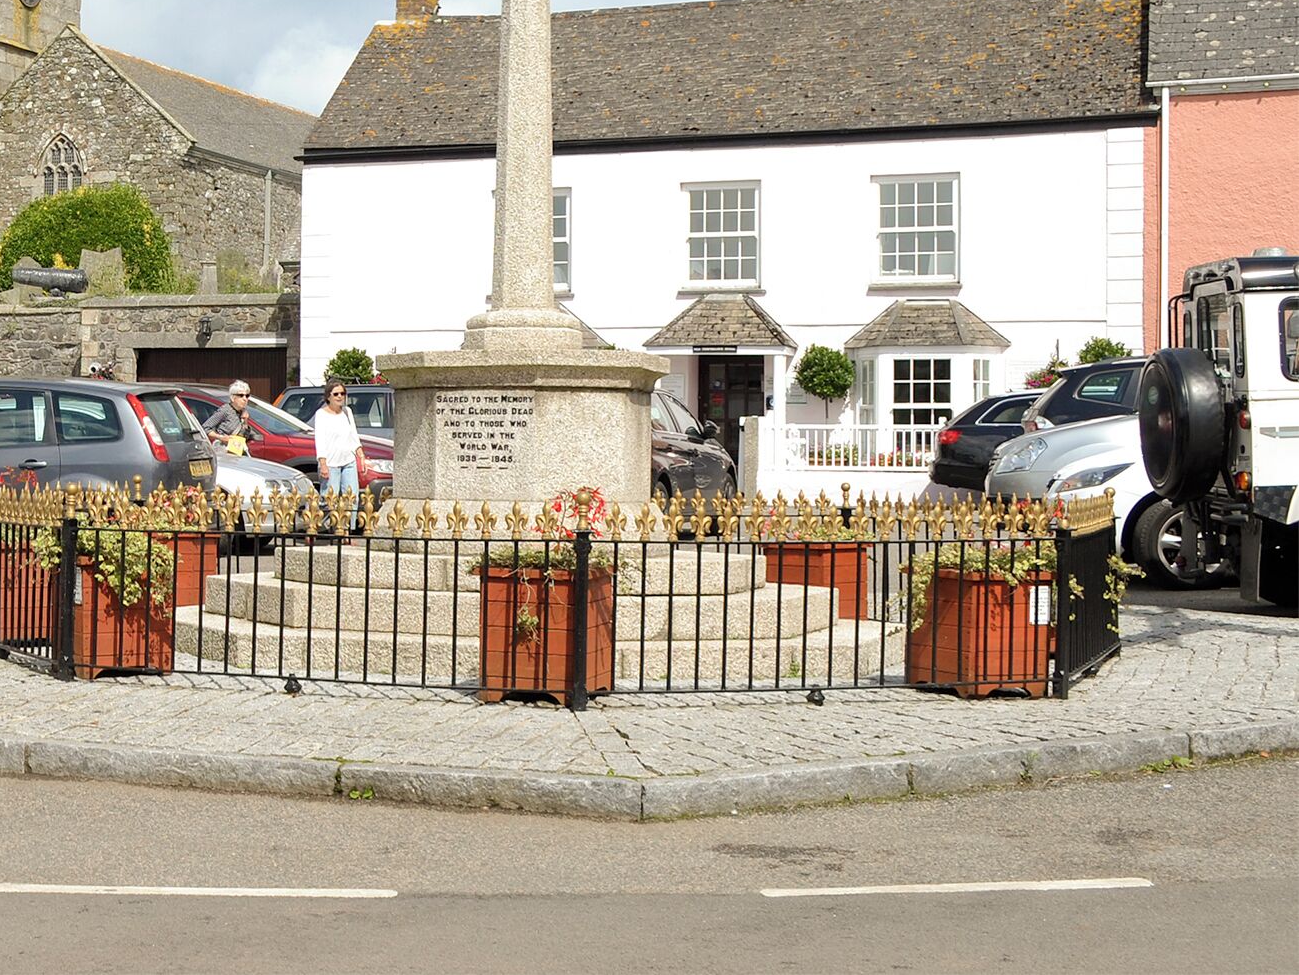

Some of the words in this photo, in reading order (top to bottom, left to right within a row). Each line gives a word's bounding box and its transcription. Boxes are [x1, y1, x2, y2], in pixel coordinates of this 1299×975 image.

[479, 420, 505, 428] THOSE
[509, 420, 527, 428] WHO
[451, 431, 483, 439] SERVED
[459, 442, 487, 450] WORLD
